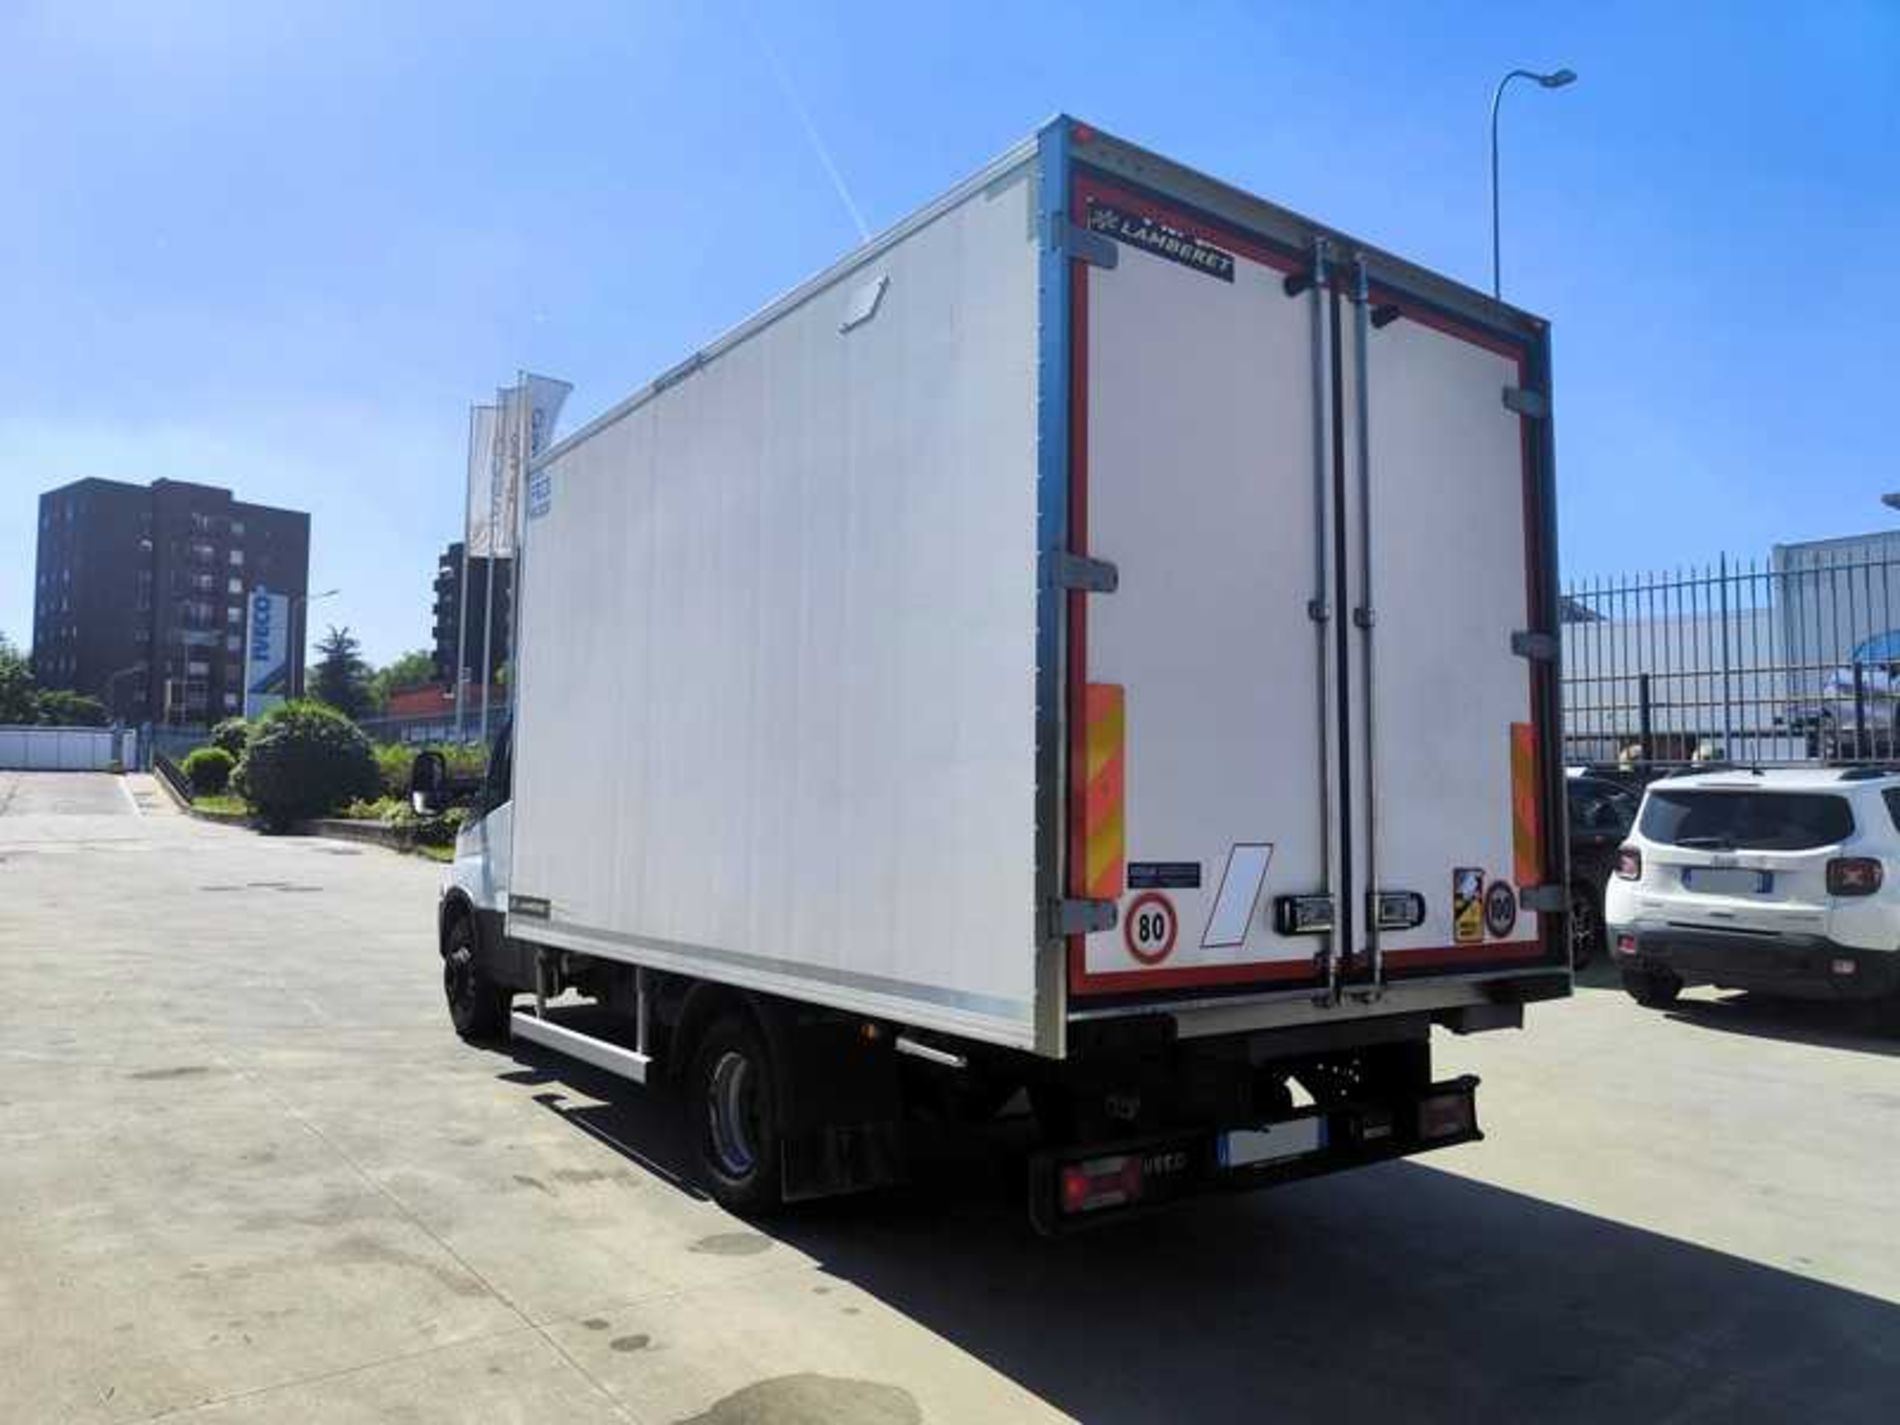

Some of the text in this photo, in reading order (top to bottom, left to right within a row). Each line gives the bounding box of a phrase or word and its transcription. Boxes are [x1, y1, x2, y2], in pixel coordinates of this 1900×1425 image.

[1120, 220, 1232, 271] LAMBERET
[252, 595, 271, 661] IVECO
[1138, 912, 1165, 943] 80
